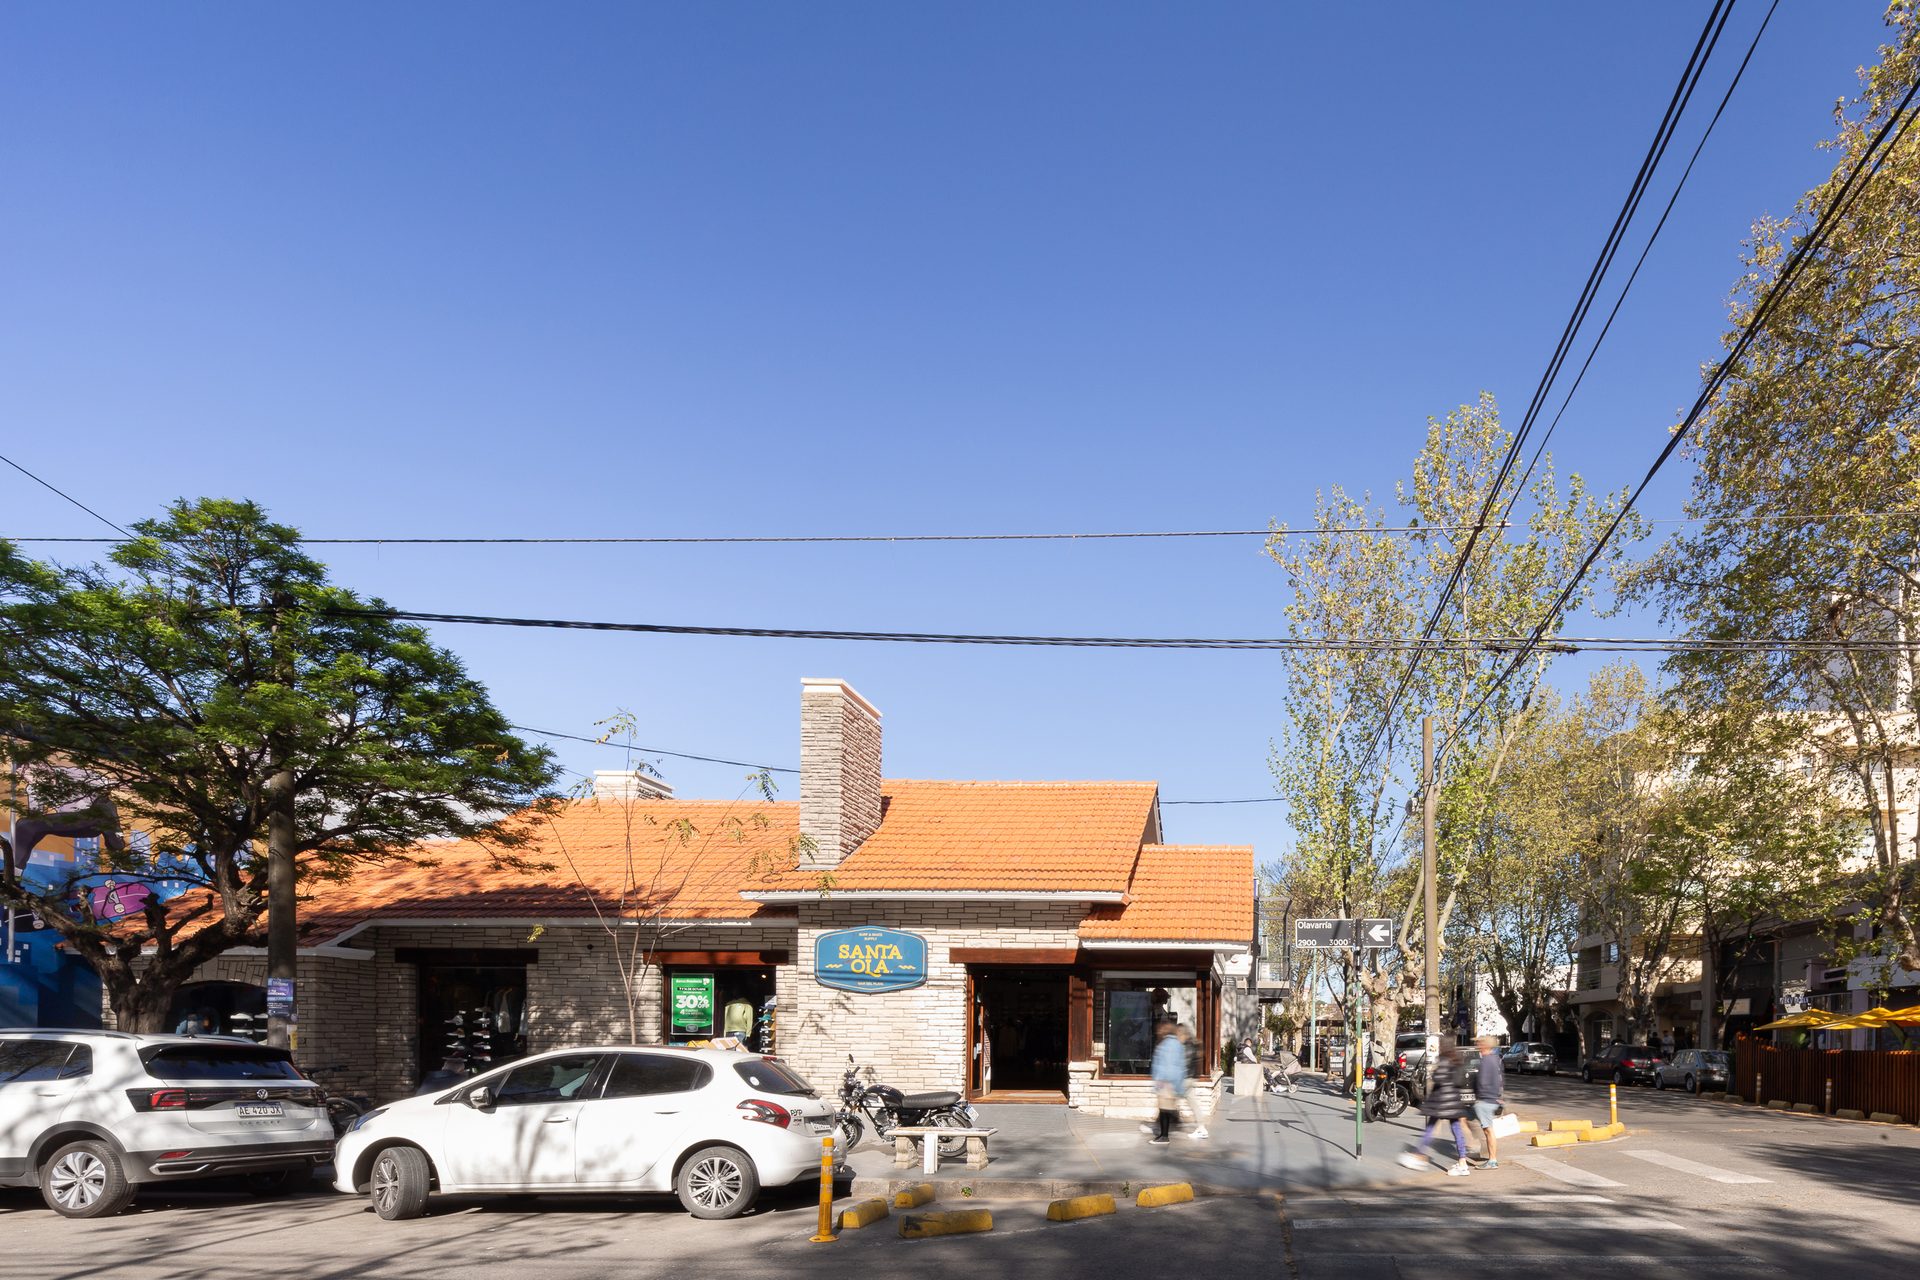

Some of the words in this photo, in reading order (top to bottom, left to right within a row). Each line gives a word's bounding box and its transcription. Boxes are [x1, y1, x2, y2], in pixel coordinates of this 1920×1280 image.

[838, 944, 903, 960] SANTA
[675, 995, 709, 1008] 30%
[240, 1107, 250, 1115] AE
